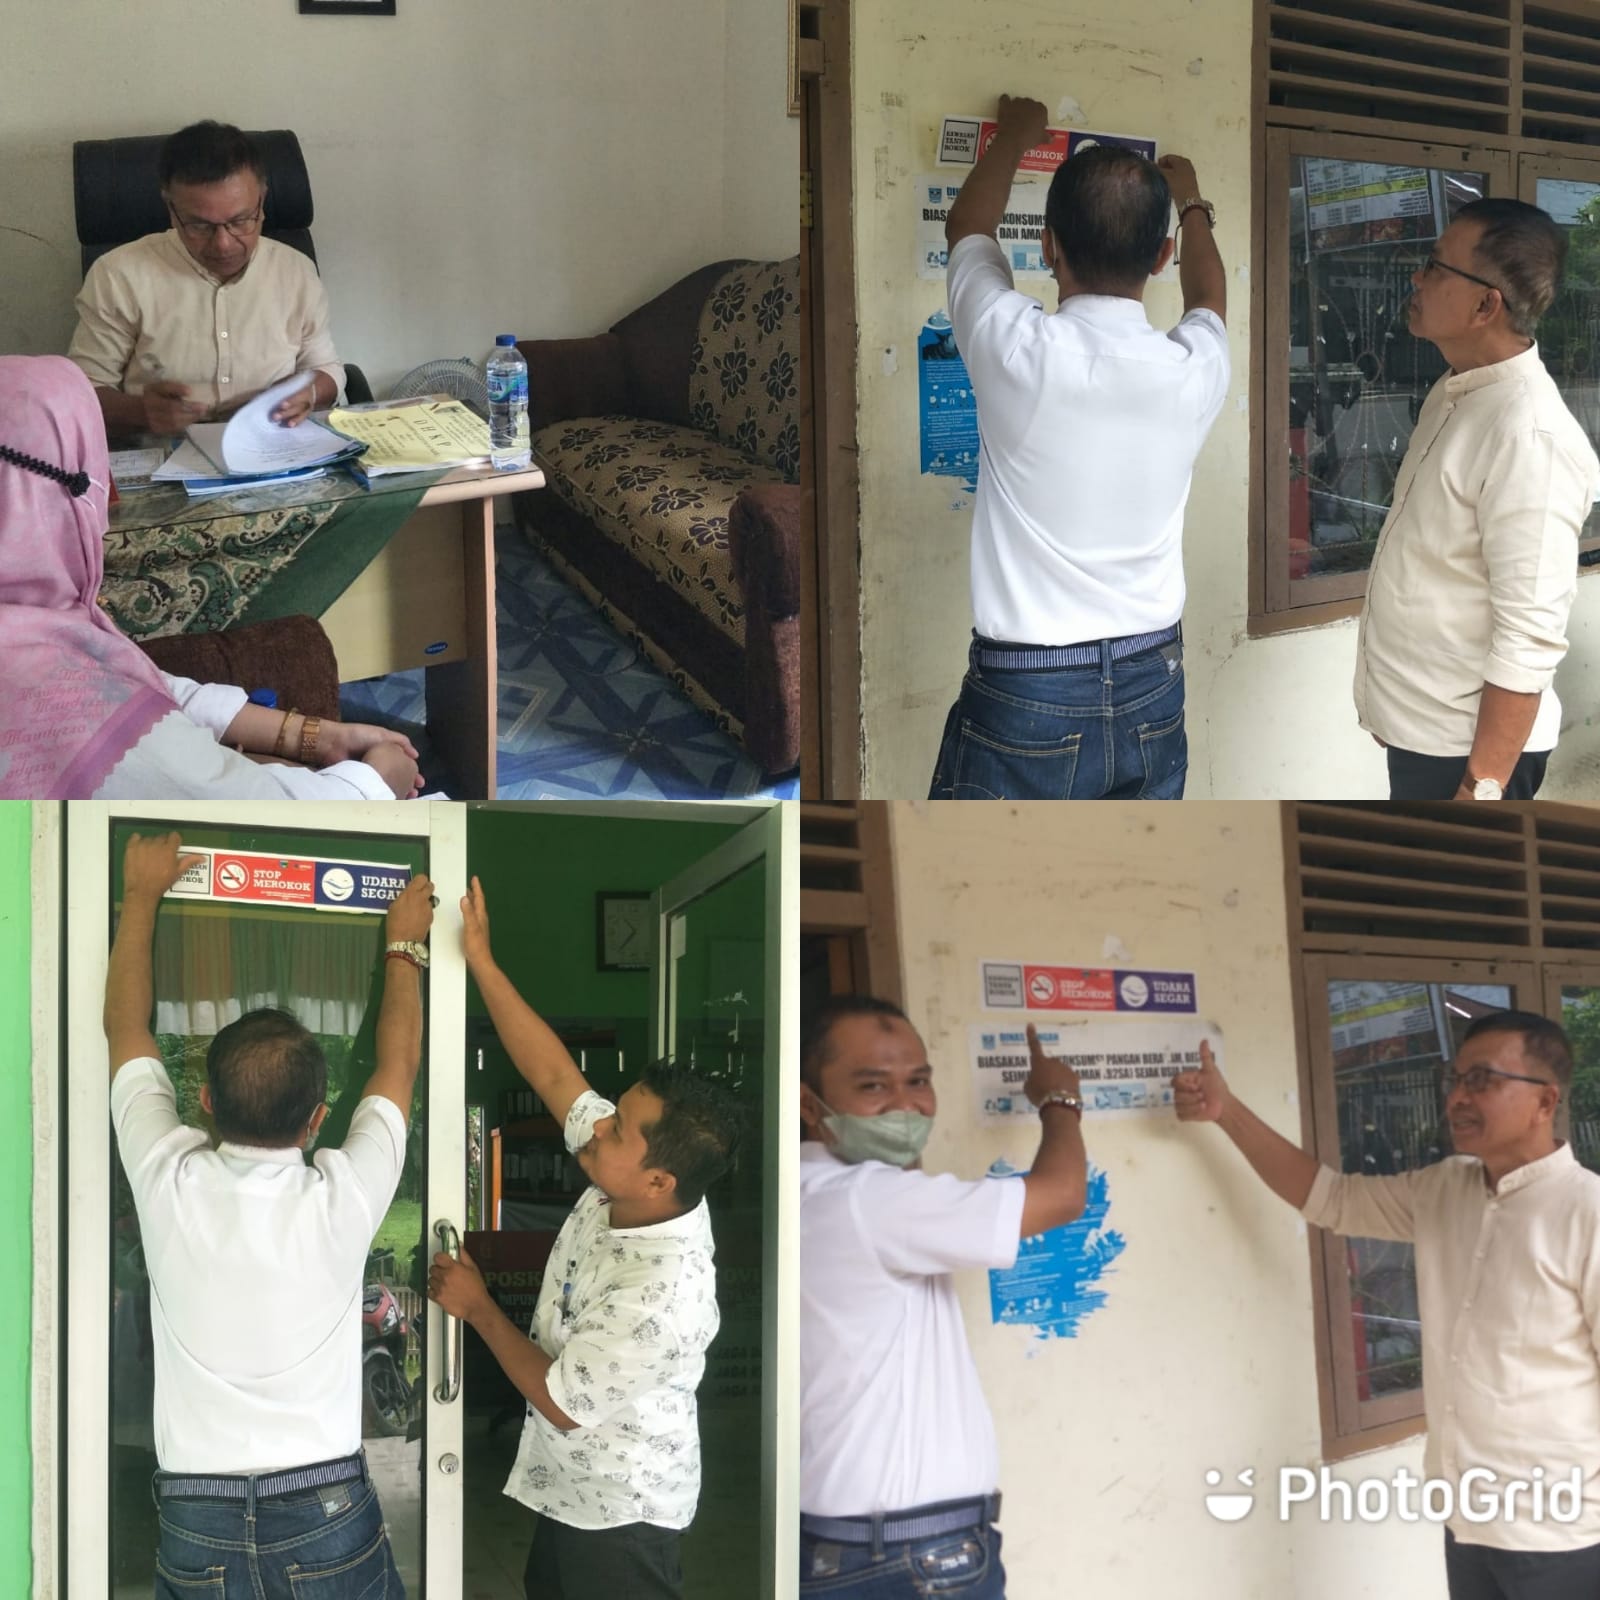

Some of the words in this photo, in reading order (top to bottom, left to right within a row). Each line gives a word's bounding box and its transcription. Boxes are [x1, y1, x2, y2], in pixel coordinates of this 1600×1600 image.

[999, 227, 1018, 240] DAN
[1021, 228, 1042, 240] AMA
[253, 869, 282, 880] STOP
[253, 879, 312, 892] MEROKOK
[361, 875, 406, 889] UDARA
[1152, 980, 1191, 993] UDARA
[1153, 993, 1191, 1005] SEGAR
[977, 1055, 1028, 1069] BIASAKAN
